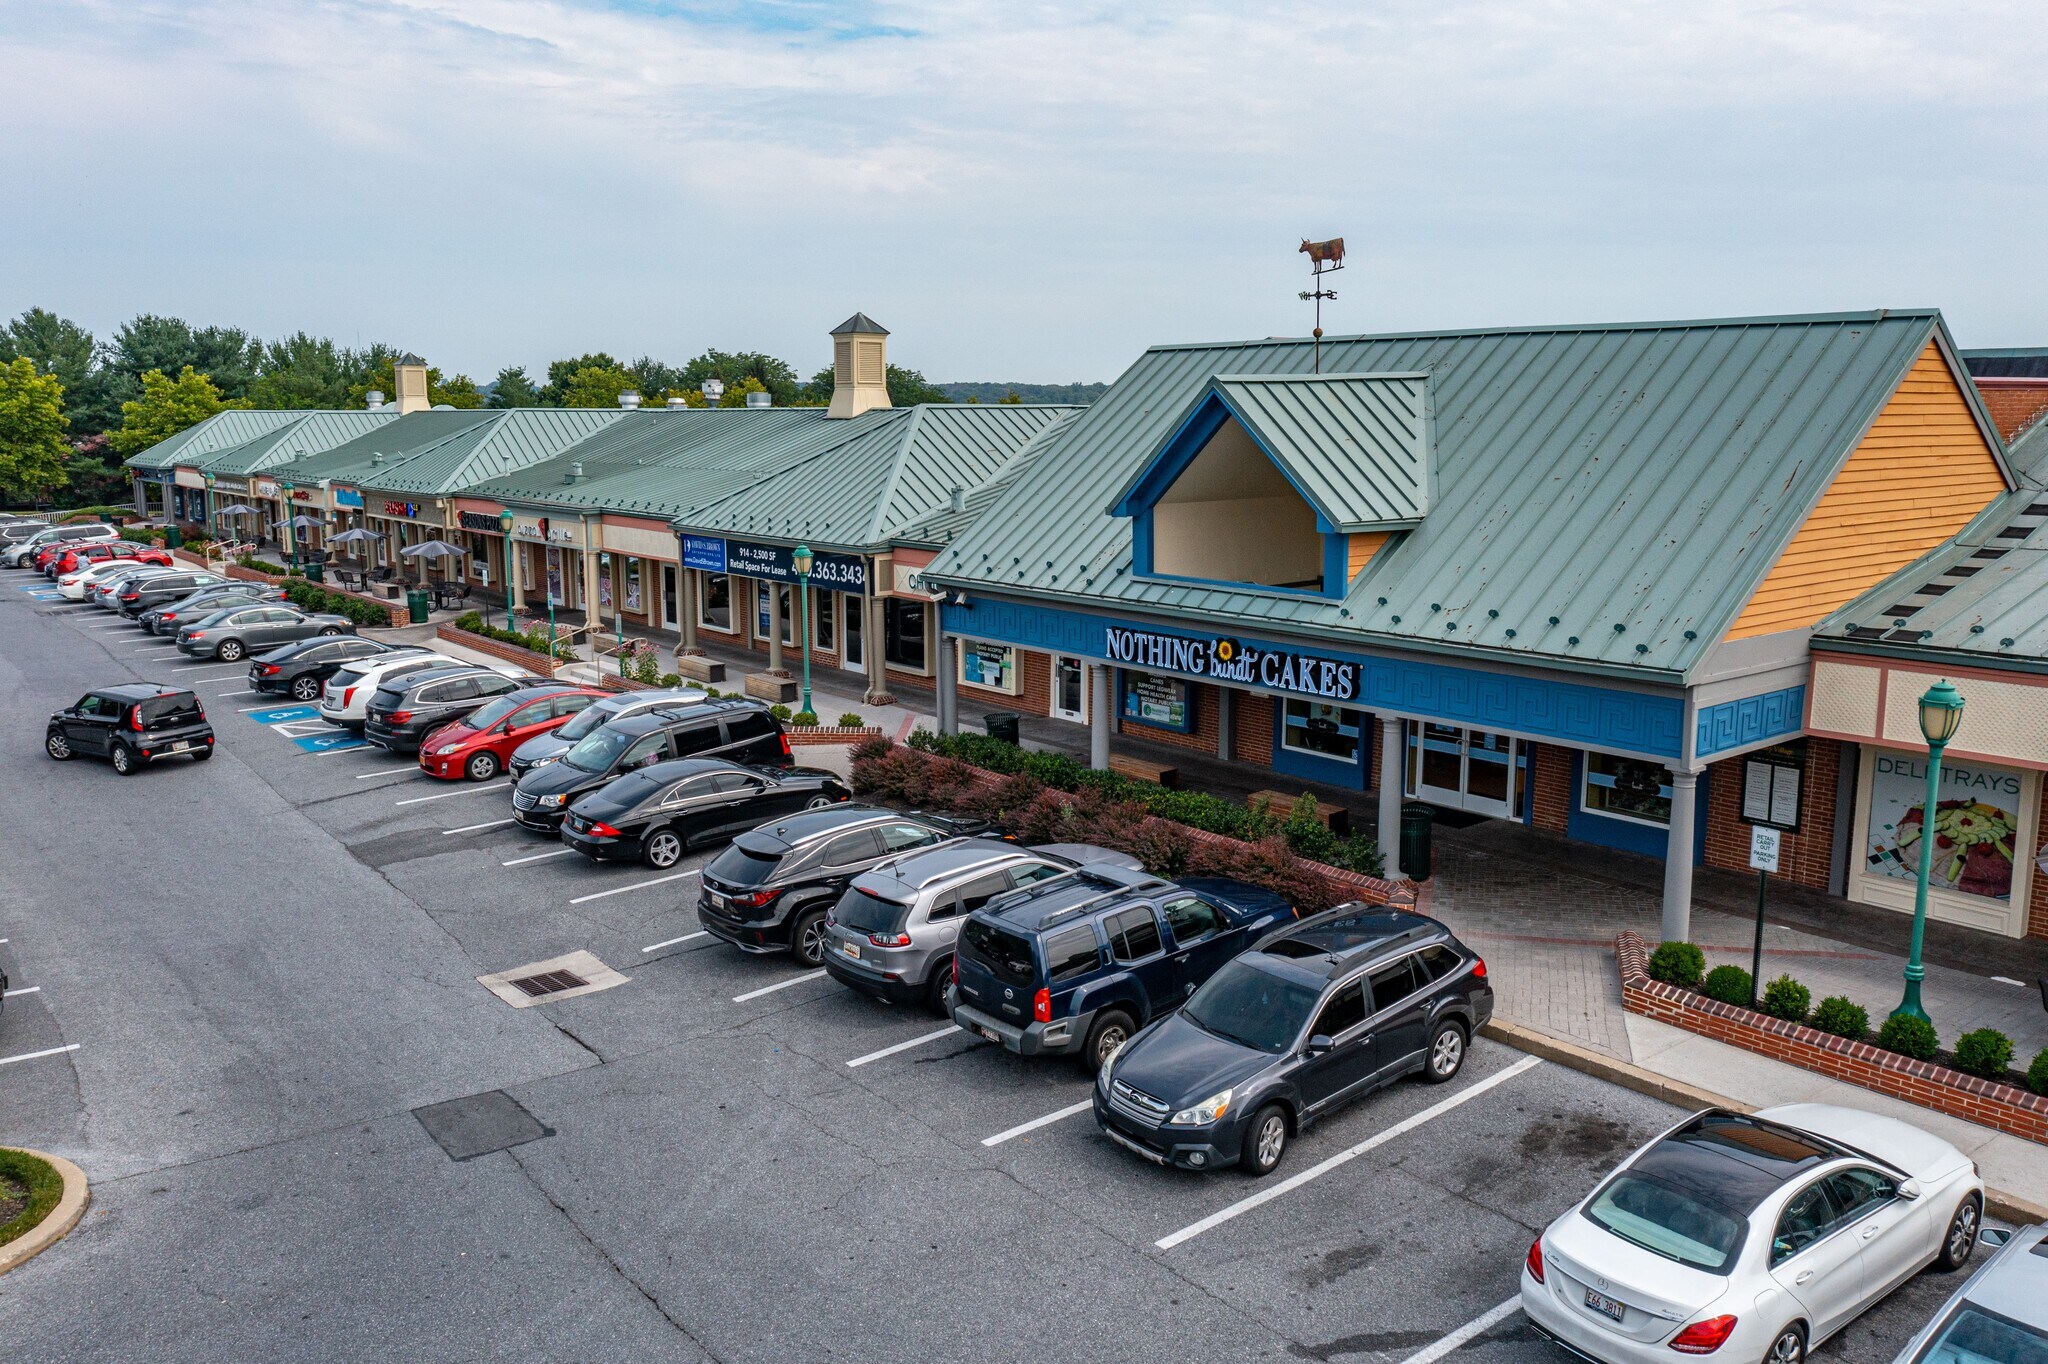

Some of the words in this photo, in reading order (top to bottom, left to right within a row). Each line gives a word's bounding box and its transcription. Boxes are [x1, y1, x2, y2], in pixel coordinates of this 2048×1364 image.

[740, 547, 749, 557] 914
[753, 549, 768, 560] 2,500
[769, 552, 776, 561] SF
[730, 558, 744, 569] Retail
[745, 561, 760, 572] Space
[761, 563, 770, 573] For
[771, 565, 787, 576] Lease
[1106, 628, 1204, 673] NOTHING
[1207, 639, 1258, 683] bundt
[1261, 654, 1353, 699] CAKES
[1138, 682, 1156, 690] SUPPORT
[1940, 766, 2020, 795] TRAYS
[1756, 839, 1775, 847] CARRY
[1757, 834, 1774, 842] RETAIL
[1753, 850, 1776, 860] PARKING
[1757, 856, 1771, 864] ONLY
[1587, 1292, 1600, 1308] E66
[1603, 1300, 1622, 1319] 3811
